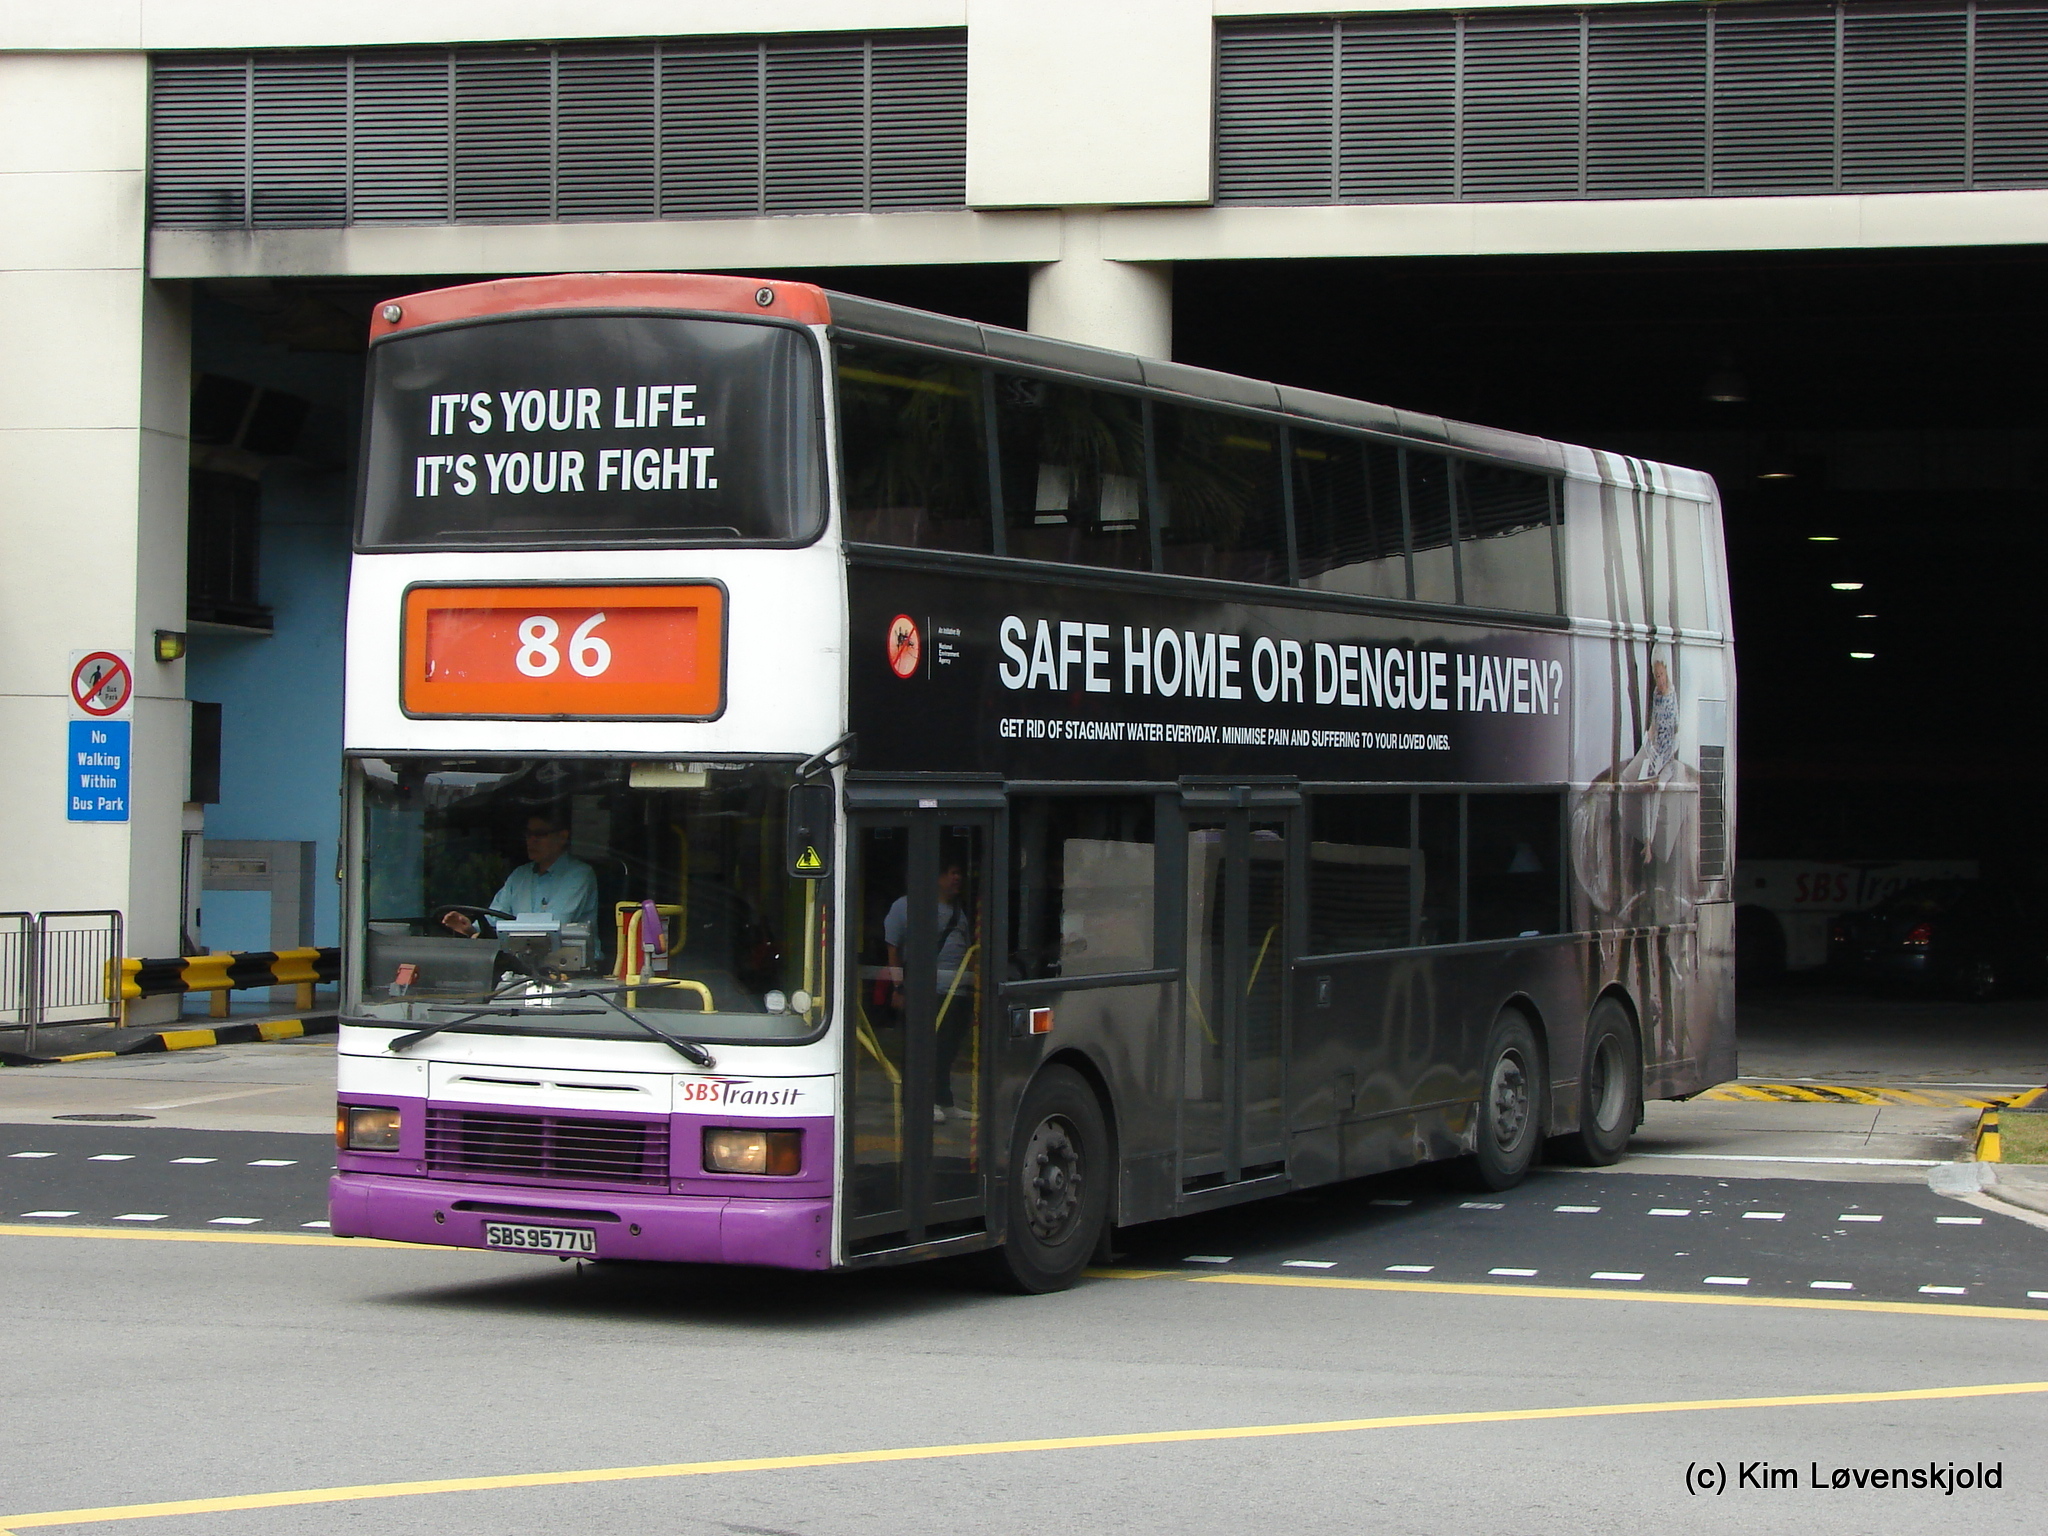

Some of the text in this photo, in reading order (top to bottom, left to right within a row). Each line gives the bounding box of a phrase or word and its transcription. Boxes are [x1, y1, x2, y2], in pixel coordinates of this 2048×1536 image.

[429, 384, 707, 436] IT'S YOUR LIFE.
[414, 446, 719, 497] IT'S YOUR FIGHT.
[514, 611, 613, 679] 86
[999, 614, 1564, 715] SAFE HOME OR DENGUE HAVEN?
[91, 730, 107, 744] No
[999, 718, 1451, 751] GET RID OF STAGNANT WATER EVERYDAY. MINIMISE PAIN AND SUFFERING TO YOUR LOVED ONES.
[77, 752, 121, 770] Walking
[80, 774, 117, 789] Within
[72, 796, 124, 811] Bus Park
[489, 1226, 593, 1252] SBS9577U
